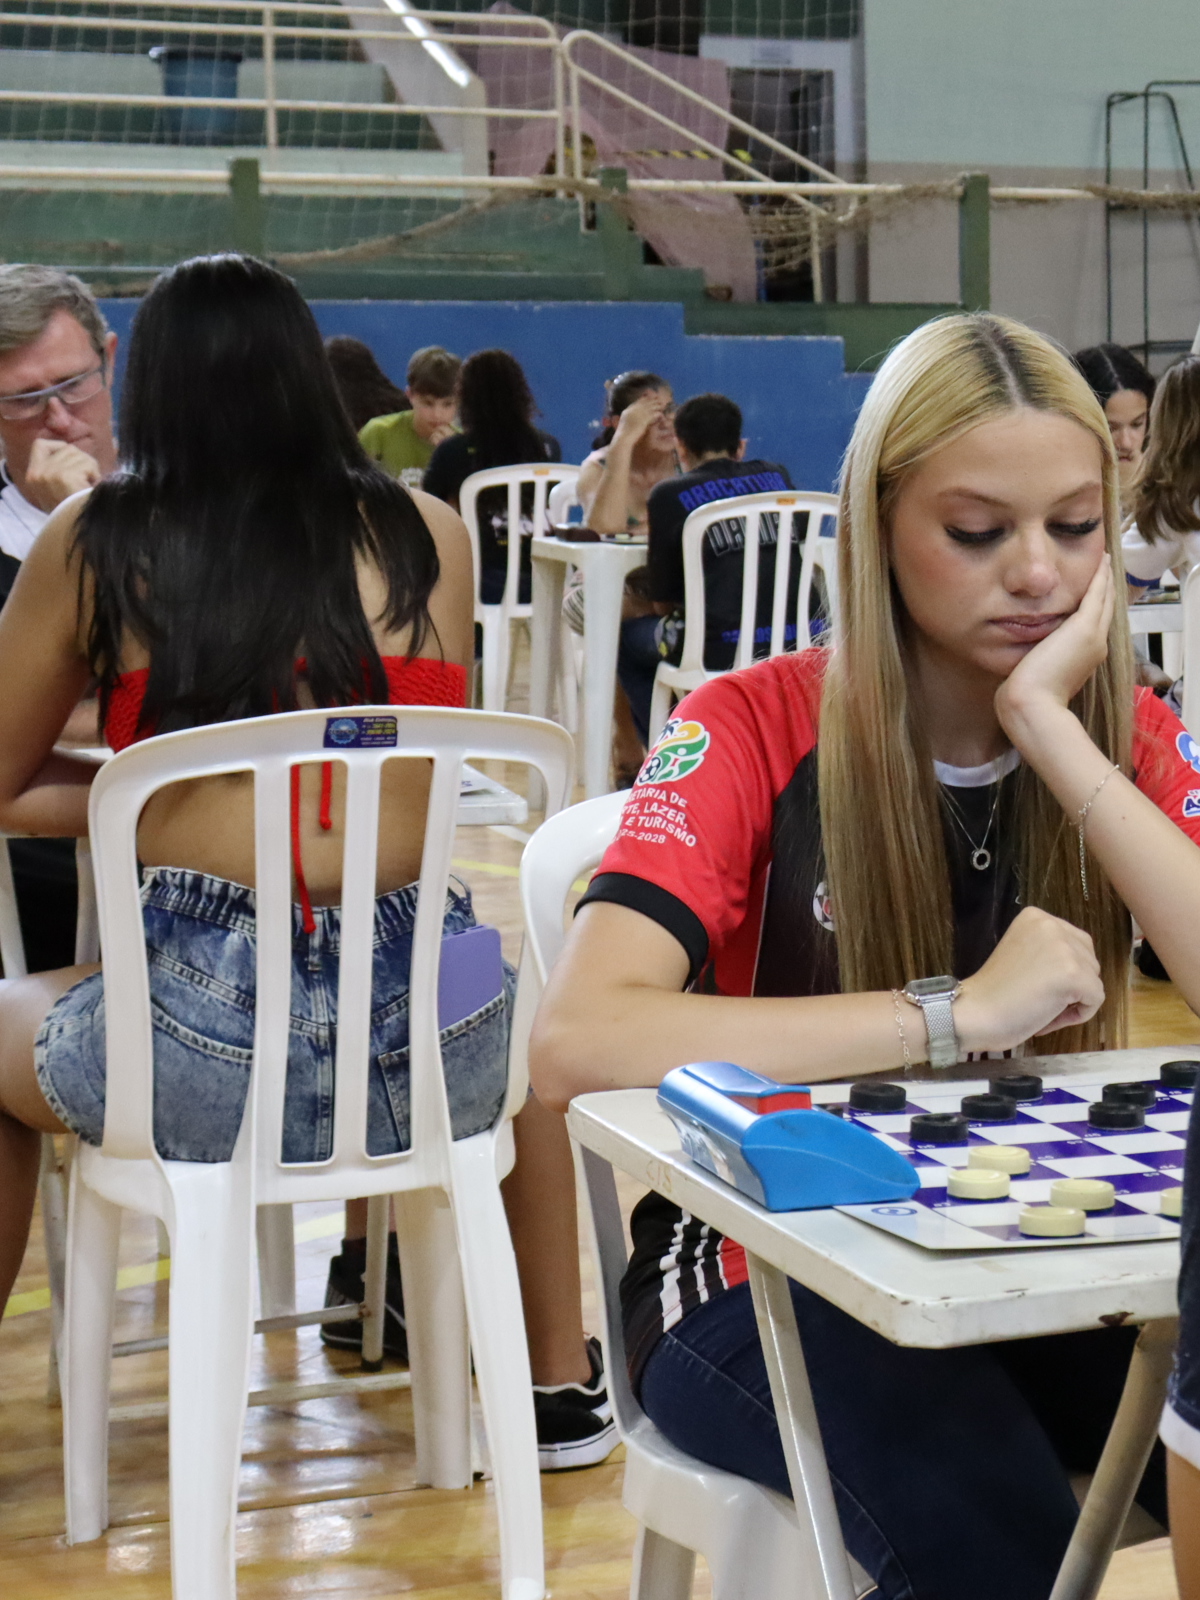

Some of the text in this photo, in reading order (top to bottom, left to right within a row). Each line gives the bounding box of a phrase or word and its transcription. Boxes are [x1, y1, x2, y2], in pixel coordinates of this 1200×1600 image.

[669, 792, 688, 807] DE
[644, 802, 688, 829] LAZER,
[625, 816, 697, 847] E TURISMO
